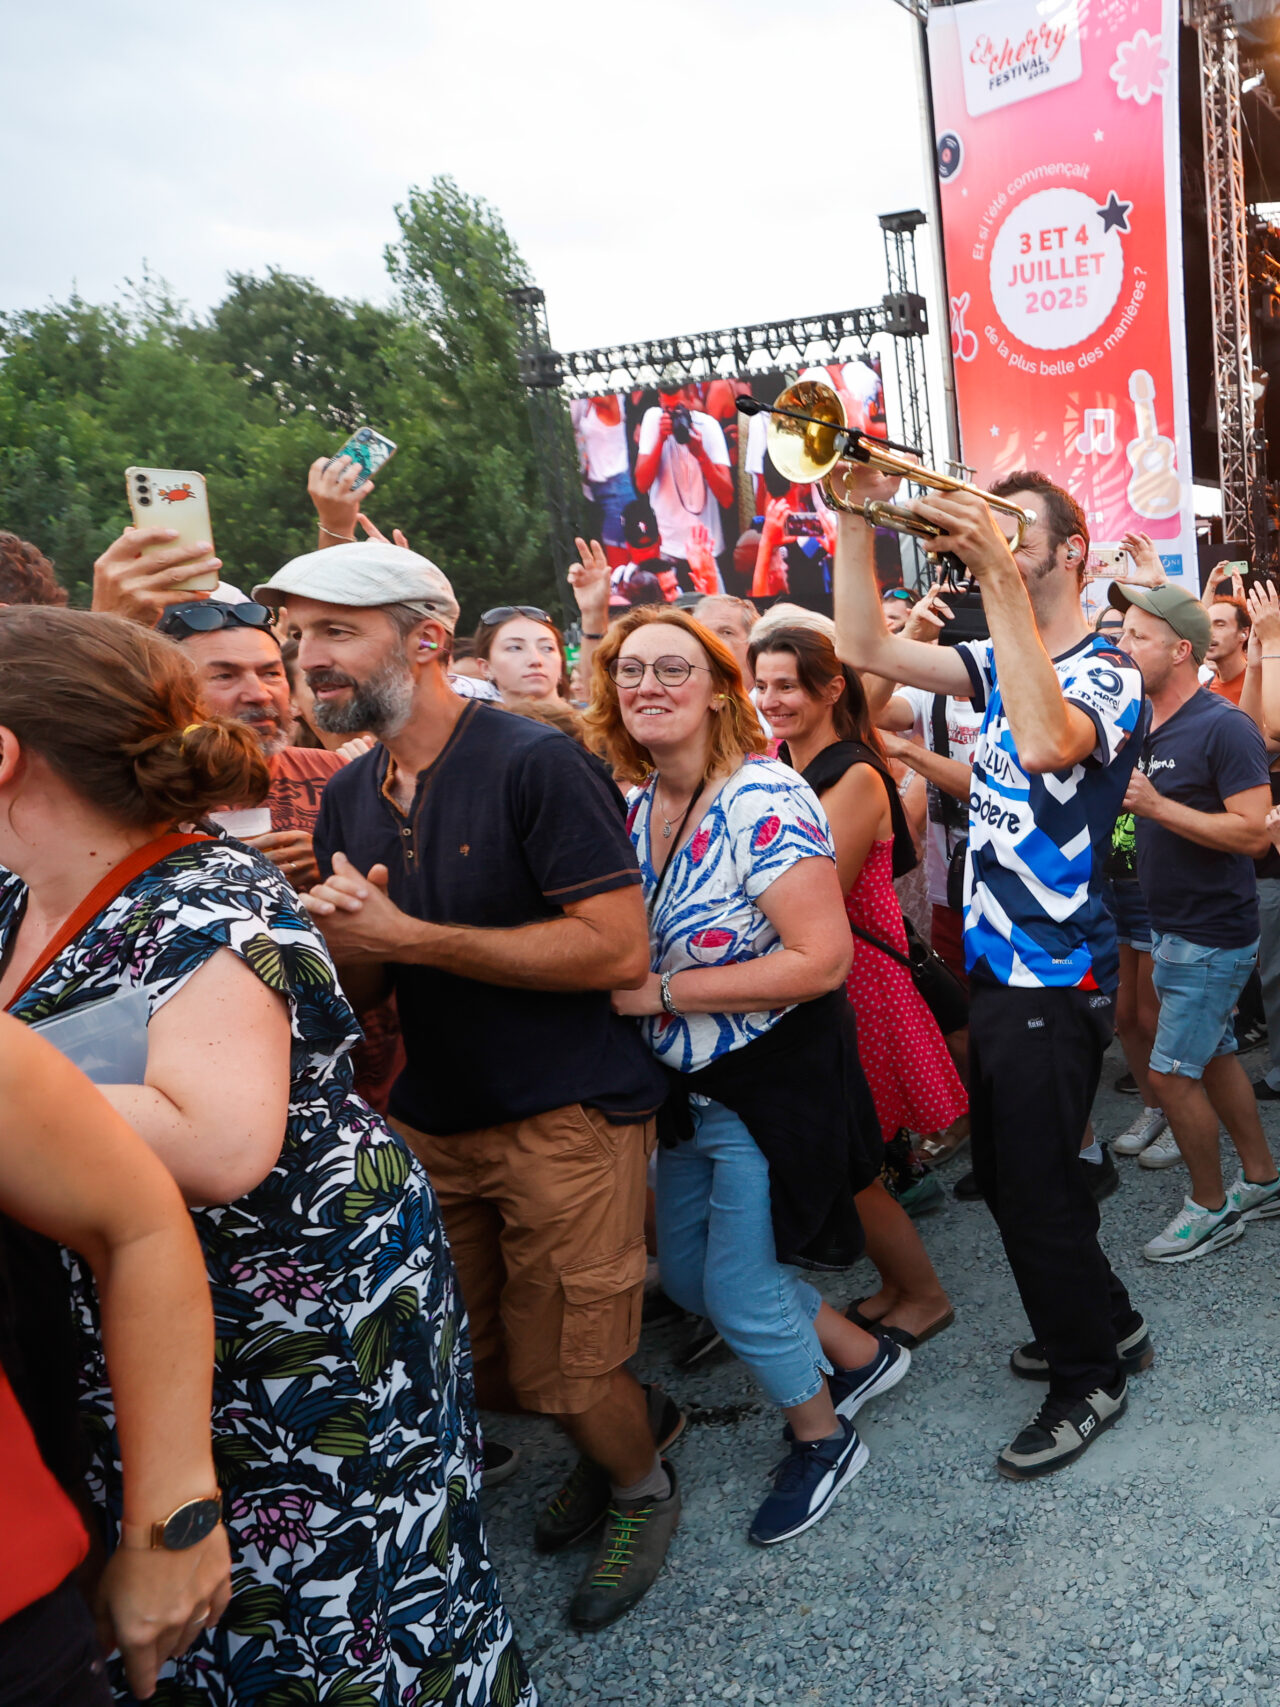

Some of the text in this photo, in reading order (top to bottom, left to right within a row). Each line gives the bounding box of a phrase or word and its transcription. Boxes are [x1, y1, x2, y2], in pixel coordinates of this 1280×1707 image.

[989, 55, 1044, 90] FESTIVAL
[972, 162, 1091, 261] Et si l'été commençait
[1019, 224, 1089, 255] 3 ET 4
[1008, 252, 1106, 287] JUILLET
[1025, 285, 1089, 314] 2025
[984, 266, 1147, 376] de la plus belle des manières ?
[969, 791, 1021, 834] odere
